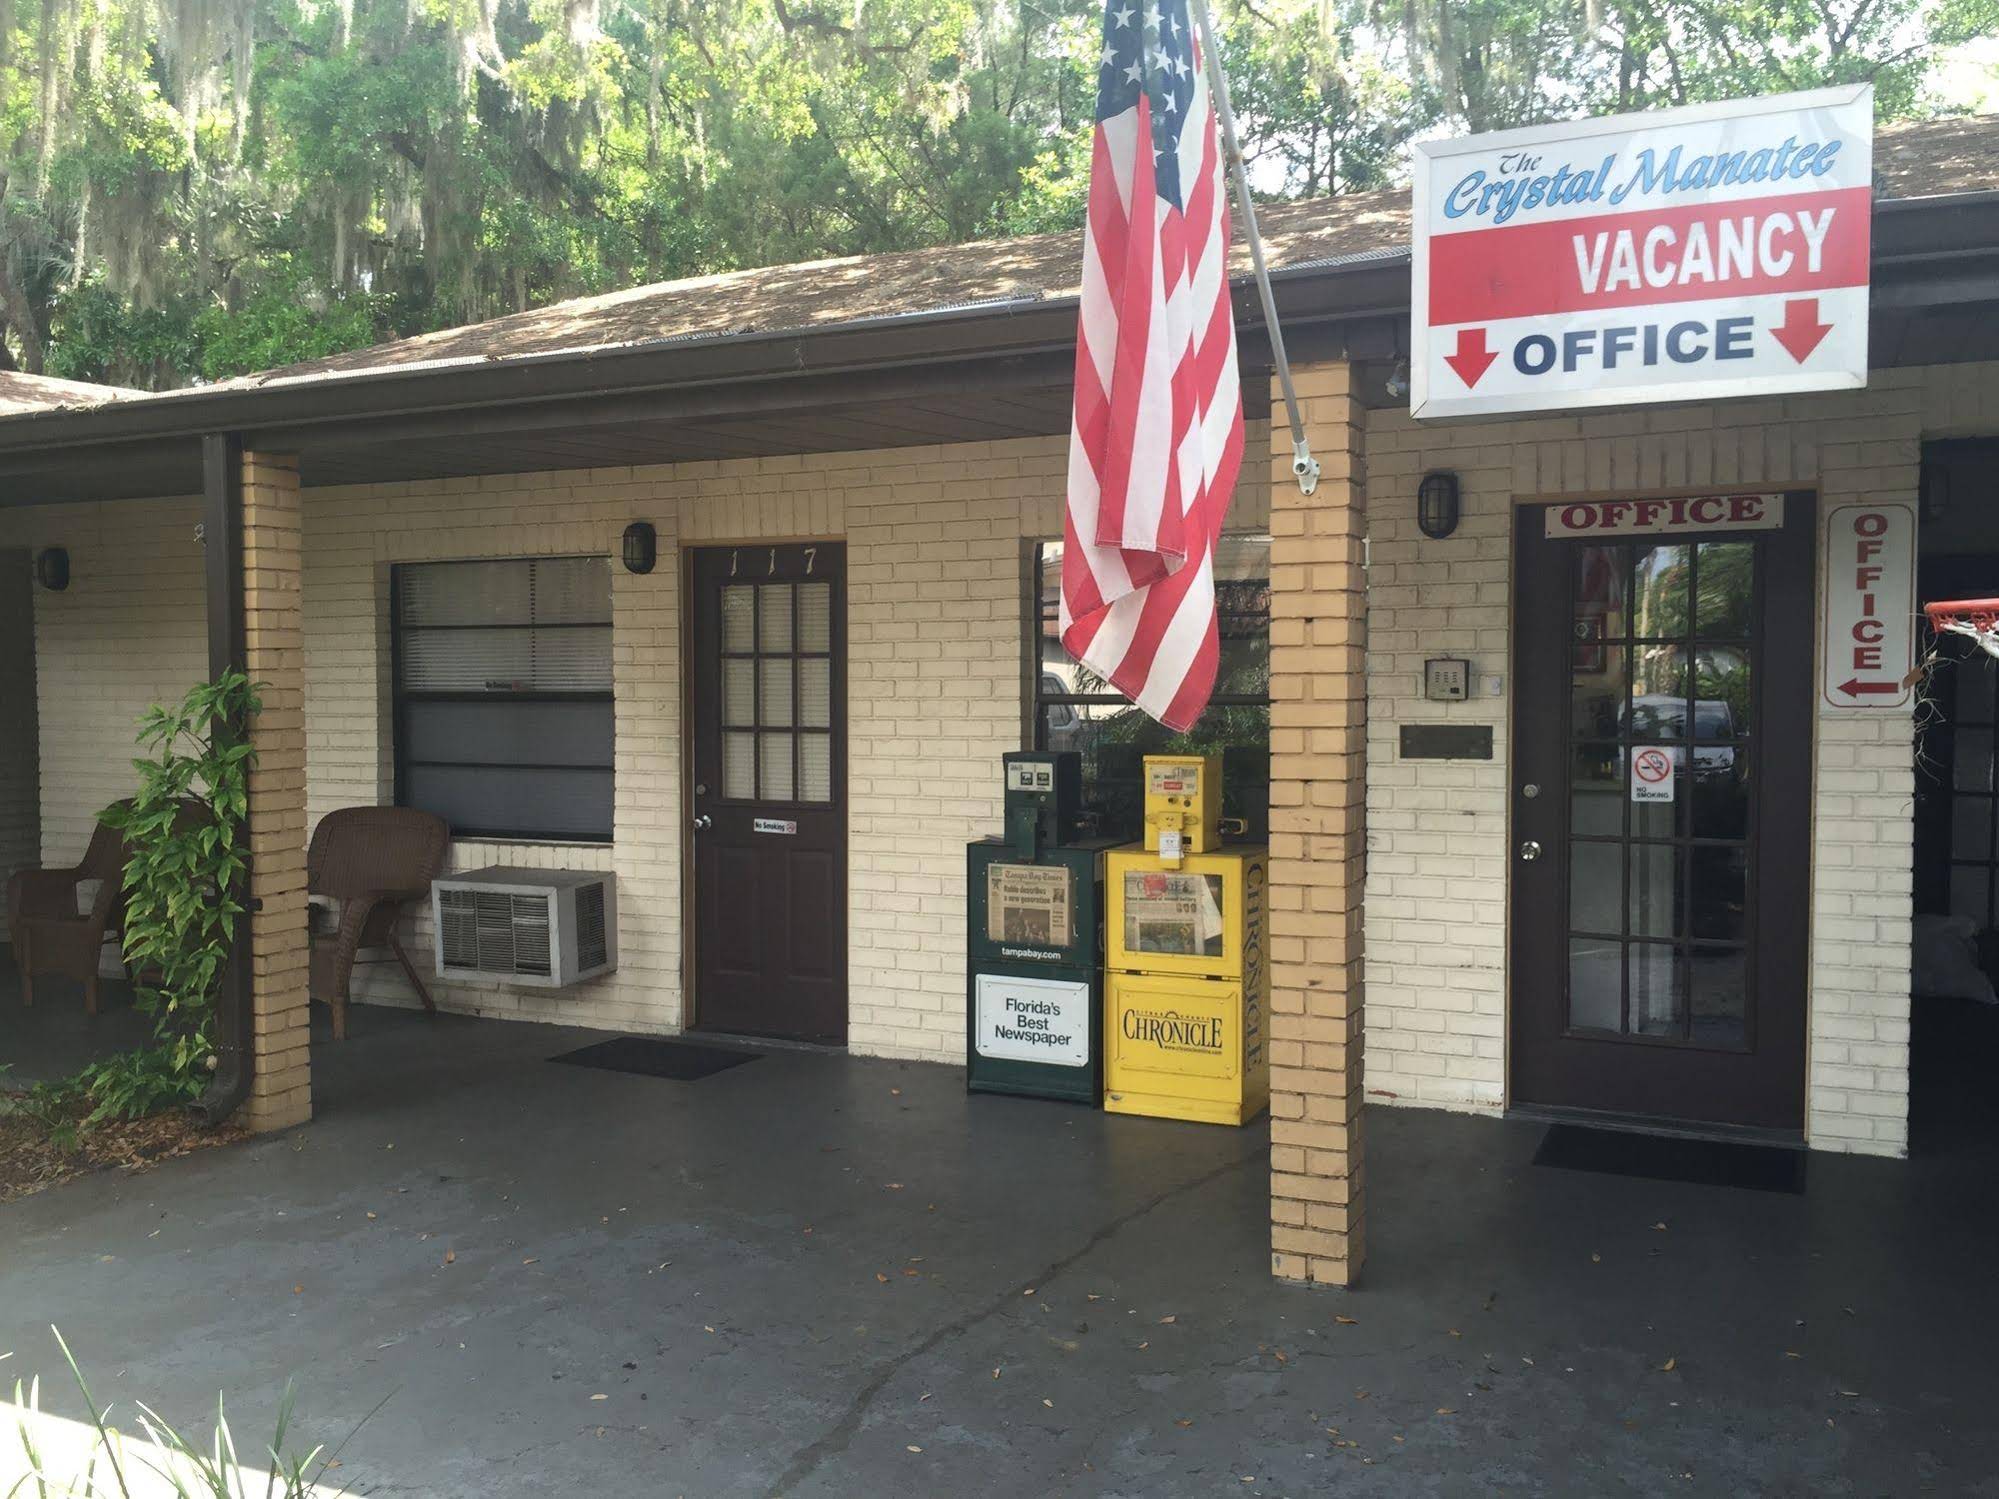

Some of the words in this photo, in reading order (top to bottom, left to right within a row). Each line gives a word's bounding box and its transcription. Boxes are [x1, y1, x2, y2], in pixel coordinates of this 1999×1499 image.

[1500, 152, 1543, 175] The
[1444, 153, 1618, 225] Crystal
[1609, 135, 1842, 205] Manatee
[1572, 208, 1837, 295] VACANCY
[1512, 316, 1755, 377] OFFICE
[1560, 496, 1765, 530] OFFICE
[730, 547, 817, 577] 117
[1852, 513, 1889, 670] OFFICE
[755, 821, 763, 829] No
[763, 822, 785, 832] Smoking
[1002, 947, 1062, 960] tampabay.com
[1242, 862, 1264, 1073] CHRONICLE
[1006, 997, 1061, 1016] Florida's
[1017, 1014, 1049, 1030] Best
[995, 1024, 1072, 1046] Newspaper
[1123, 1008, 1222, 1049] CHRONICLE
